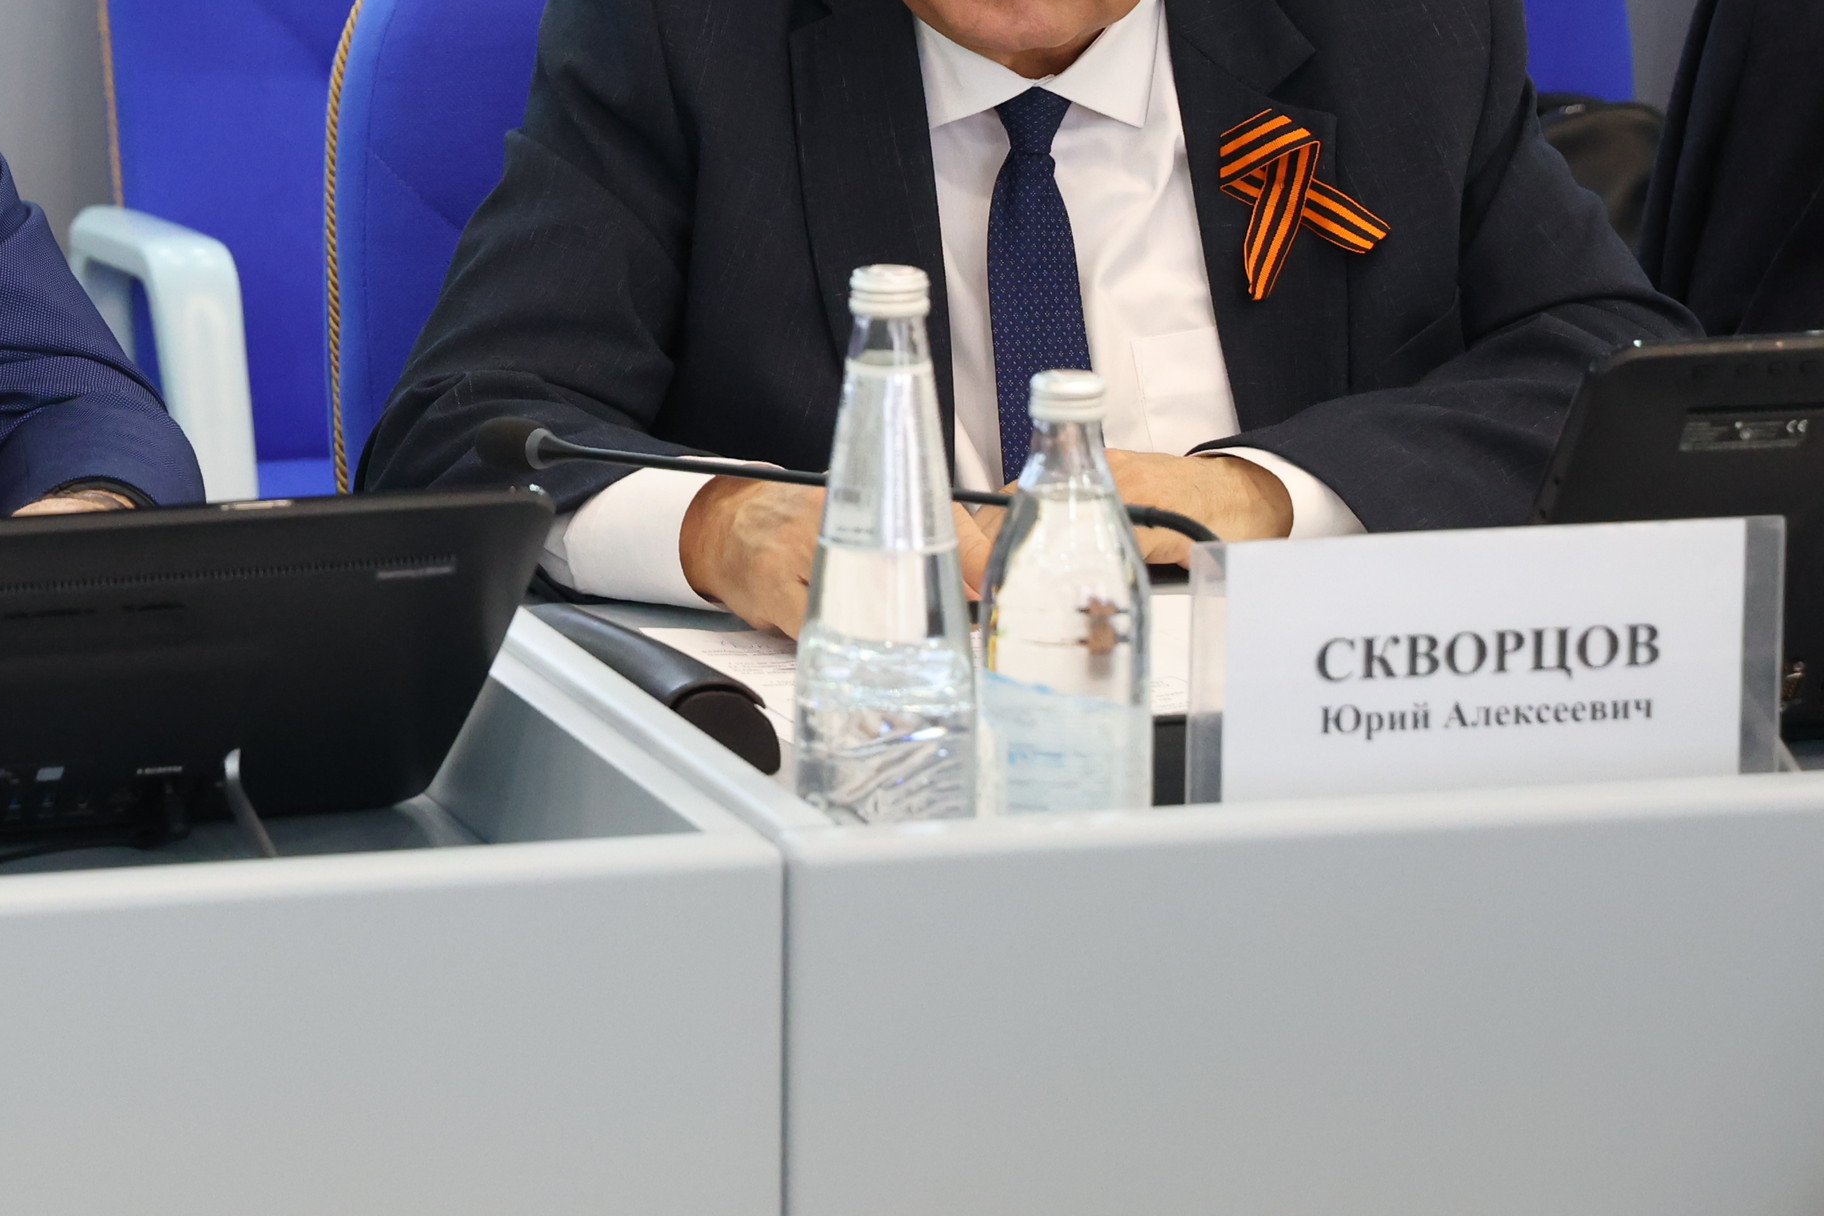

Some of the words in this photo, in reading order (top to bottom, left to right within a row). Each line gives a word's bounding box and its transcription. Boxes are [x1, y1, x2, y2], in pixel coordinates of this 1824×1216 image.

[1314, 622, 1661, 683] СКВОРЦОВ
[1319, 700, 1431, 741] Юрий
[1443, 696, 1654, 730] Алексеевич
